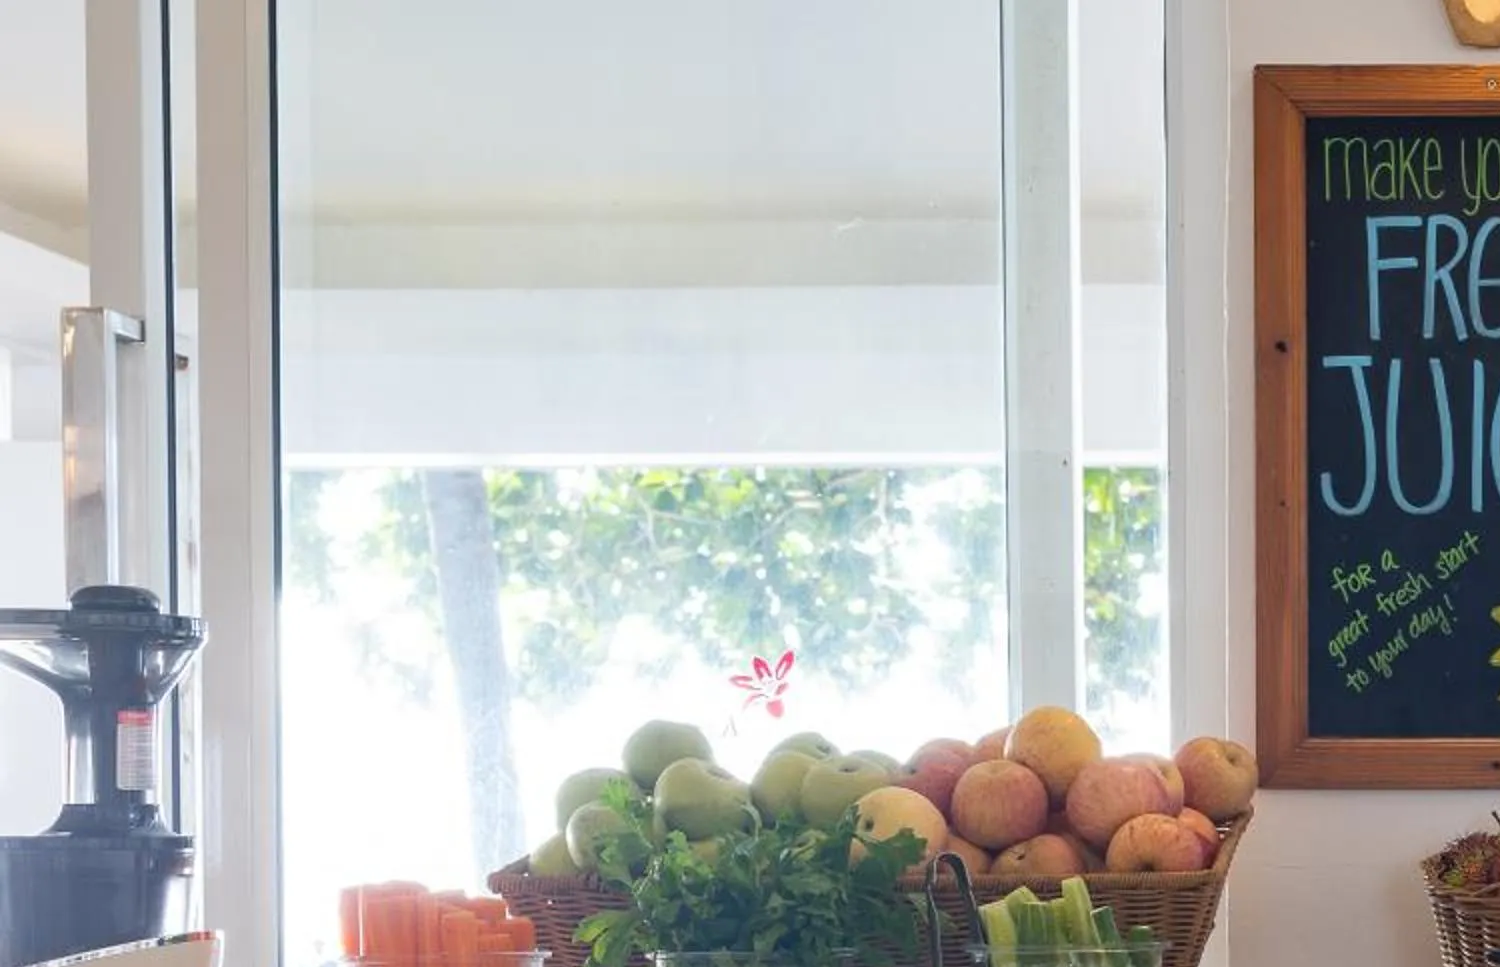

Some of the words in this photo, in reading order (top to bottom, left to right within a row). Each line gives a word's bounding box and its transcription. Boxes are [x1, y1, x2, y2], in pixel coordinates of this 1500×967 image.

[1322, 135, 1445, 201] make
[1328, 608, 1369, 668] great
[1375, 571, 1433, 617] fresh
[1435, 530, 1480, 581] start
[1381, 548, 1400, 573] a
[1346, 668, 1370, 693] to
[1367, 628, 1409, 679] your
[1409, 592, 1458, 639] day!
